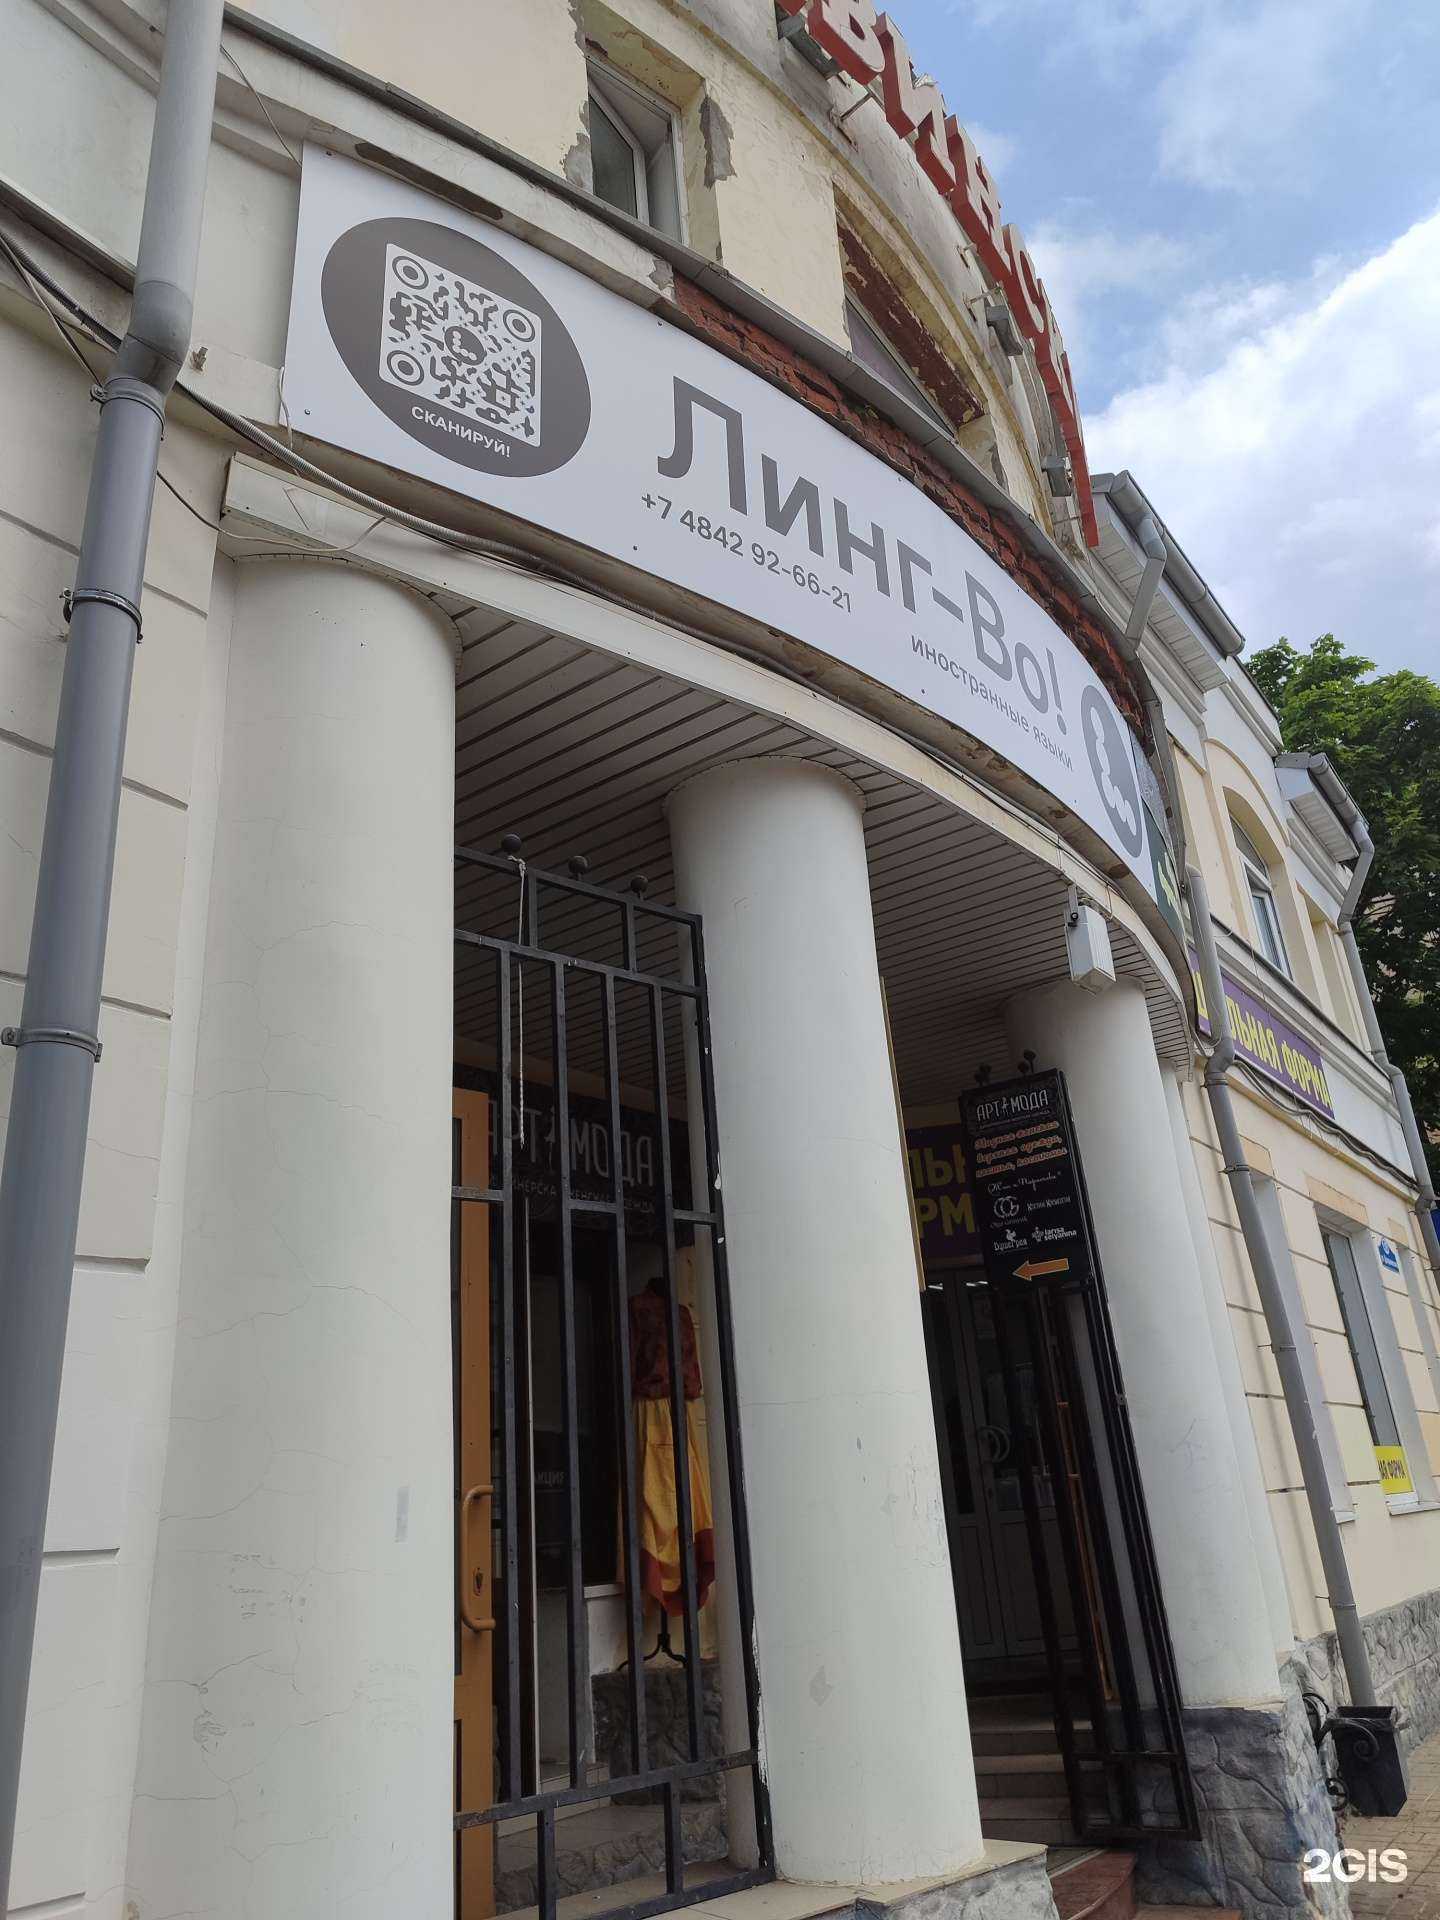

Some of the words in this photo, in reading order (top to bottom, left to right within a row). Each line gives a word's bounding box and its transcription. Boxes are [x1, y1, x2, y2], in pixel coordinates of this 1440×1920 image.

[411, 405, 511, 458] СКАНИРУЙ!
[641, 493, 672, 520] +7
[679, 509, 744, 556] 4842
[751, 547, 853, 613] 92-66-21
[657, 376, 1067, 736] Линг-Во!
[910, 634, 1030, 732] иностранные
[1032, 728, 1074, 772] языки
[976, 1101, 1003, 1121] АРТ
[1010, 1089, 1049, 1113] МОДА
[1281, 1040, 1334, 1112] ФОРМА
